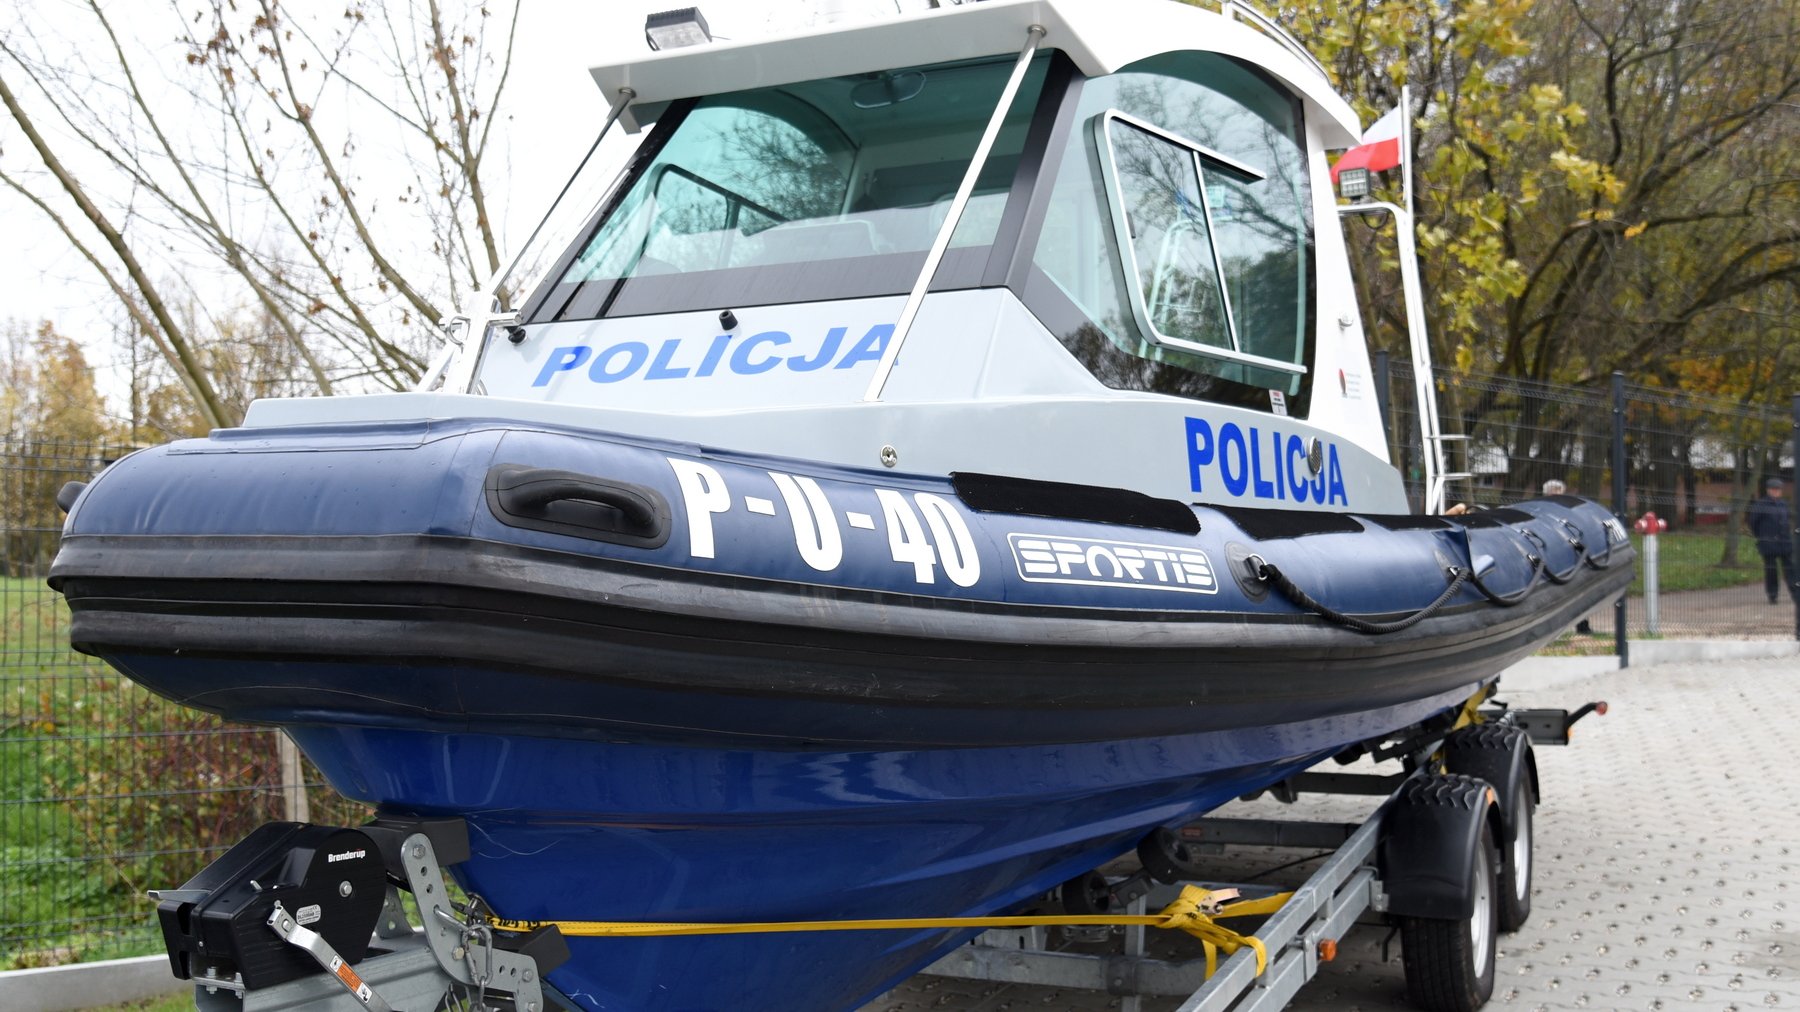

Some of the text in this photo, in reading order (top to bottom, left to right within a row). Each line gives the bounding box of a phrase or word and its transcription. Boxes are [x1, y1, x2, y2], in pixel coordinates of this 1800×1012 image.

[531, 323, 899, 387] POLICJA
[666, 457, 981, 587] P-U-40
[328, 850, 366, 862] Brenderup
